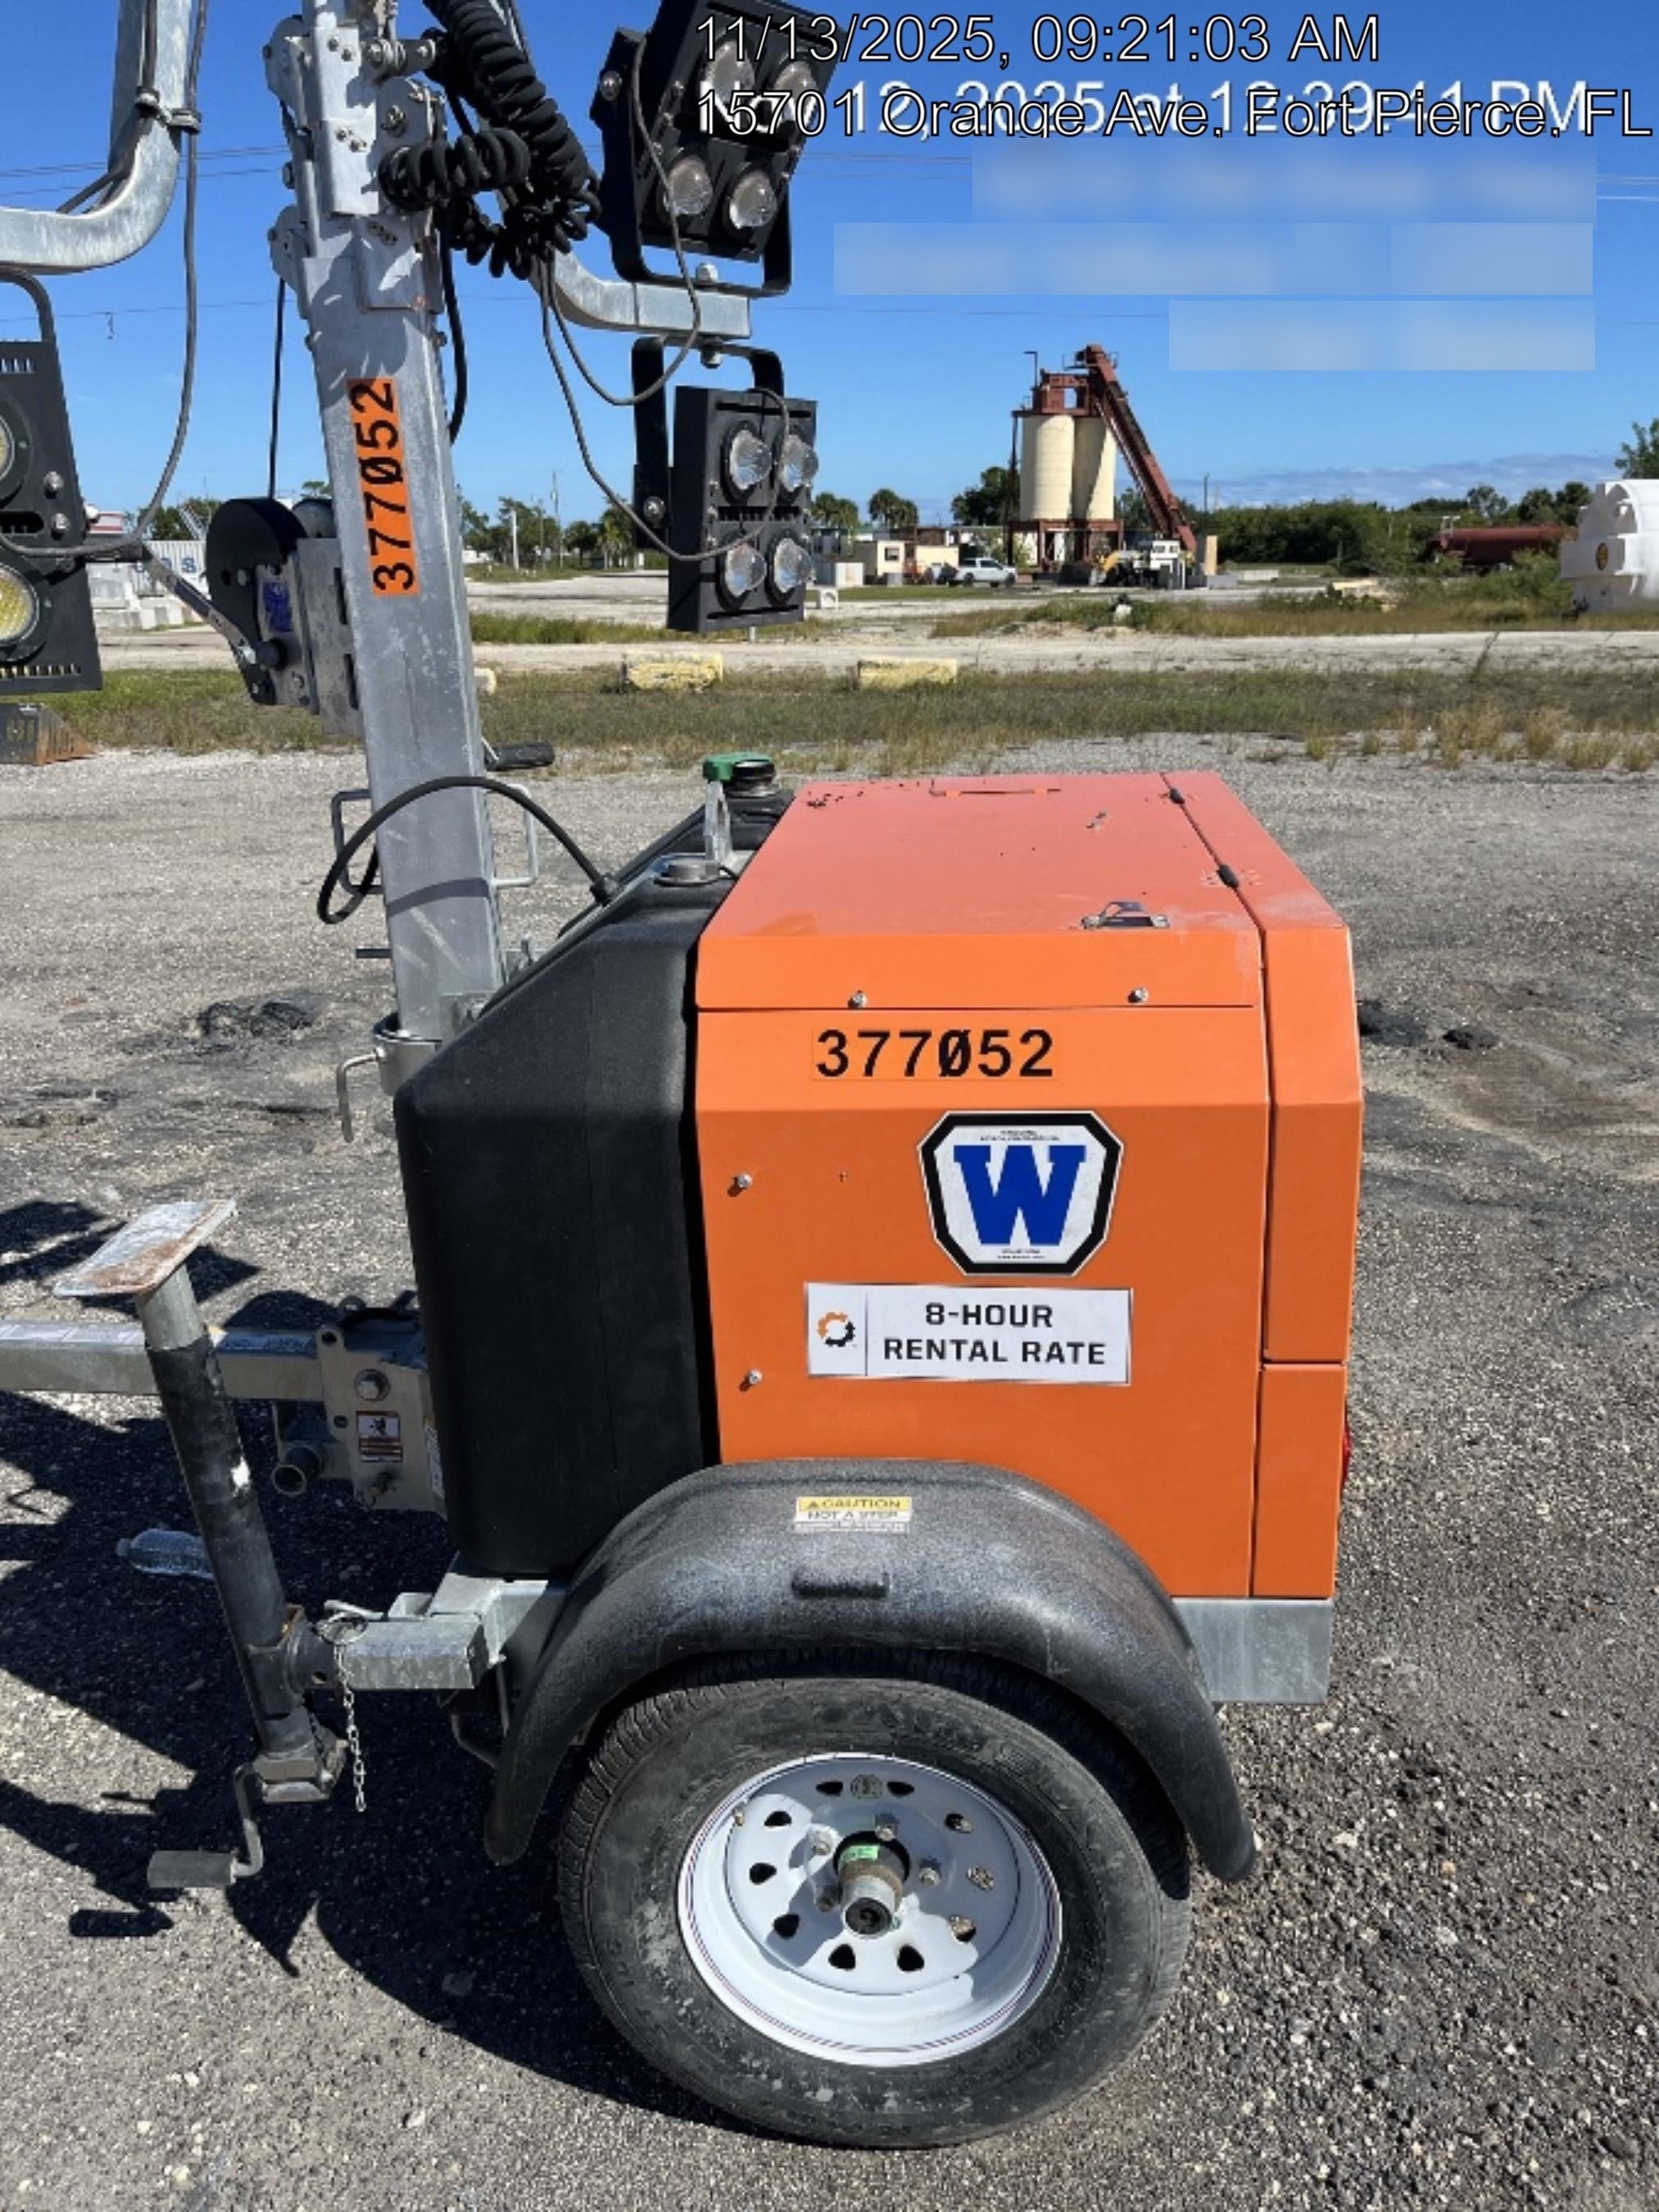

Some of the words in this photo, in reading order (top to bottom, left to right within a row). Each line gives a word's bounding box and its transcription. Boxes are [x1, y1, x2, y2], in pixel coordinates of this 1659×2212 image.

[349, 383, 414, 591] 377052
[816, 1029, 1054, 1077] 377052
[953, 1145, 1087, 1246] W
[925, 1302, 1054, 1328] 8-HOUR
[883, 1337, 1009, 1363] RENTAL
[1021, 1340, 1106, 1366] RATE
[807, 1511, 838, 1520] NOT
[823, 1498, 901, 1509] CAUTION
